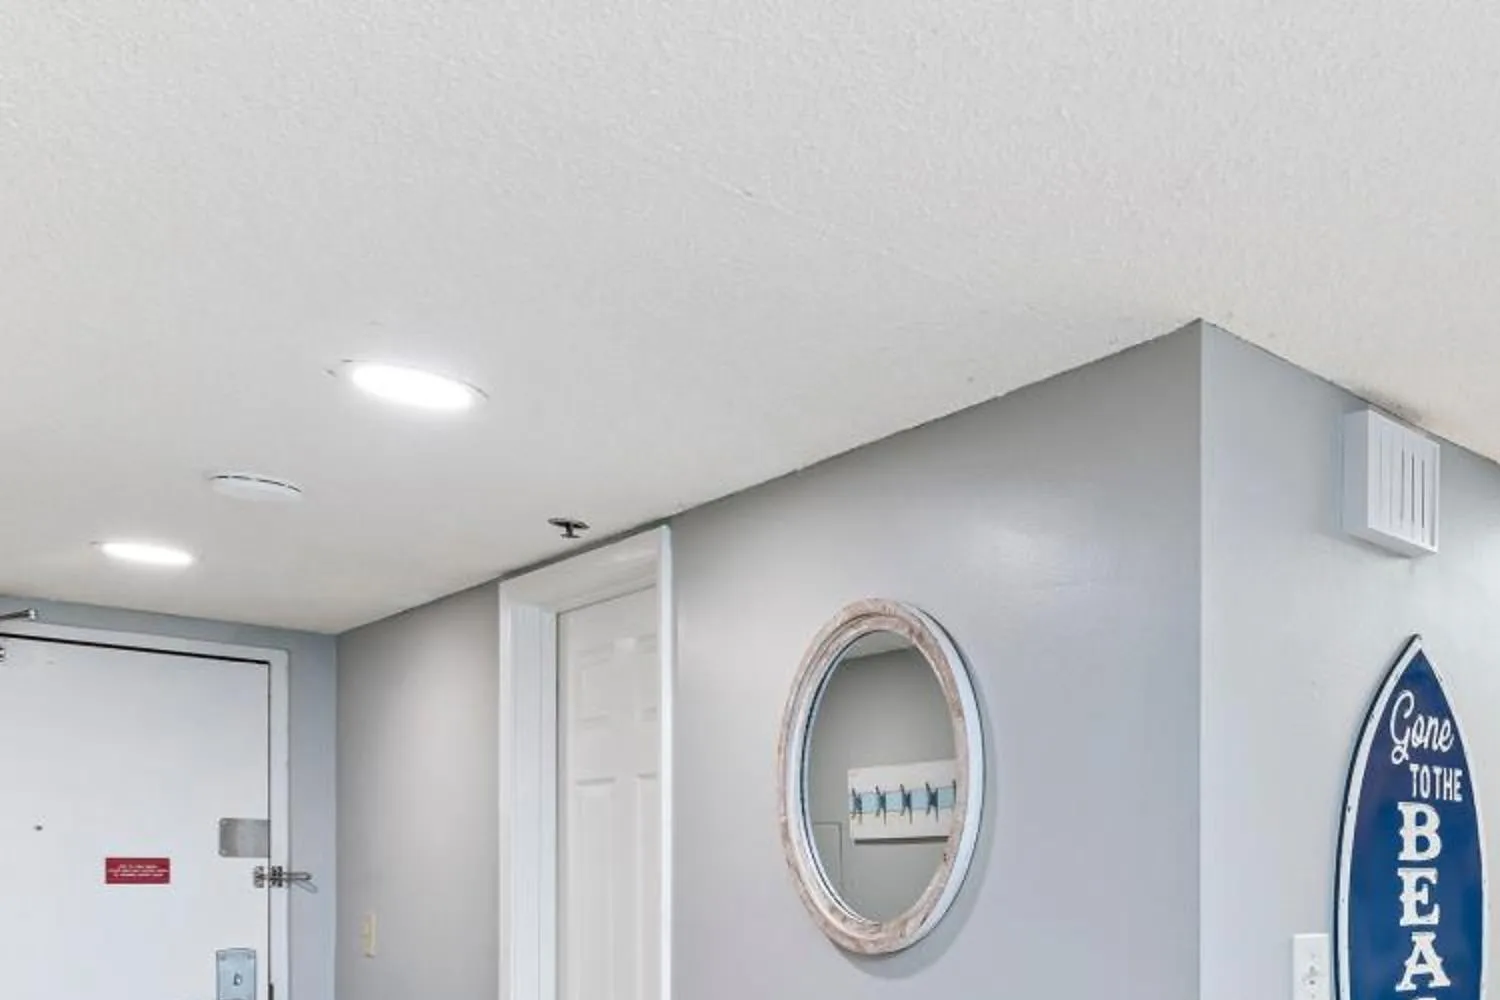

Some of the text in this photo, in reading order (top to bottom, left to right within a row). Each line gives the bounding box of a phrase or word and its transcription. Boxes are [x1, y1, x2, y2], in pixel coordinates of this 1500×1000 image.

[1390, 689, 1455, 765] Gone
[1409, 763, 1463, 802] TO THE
